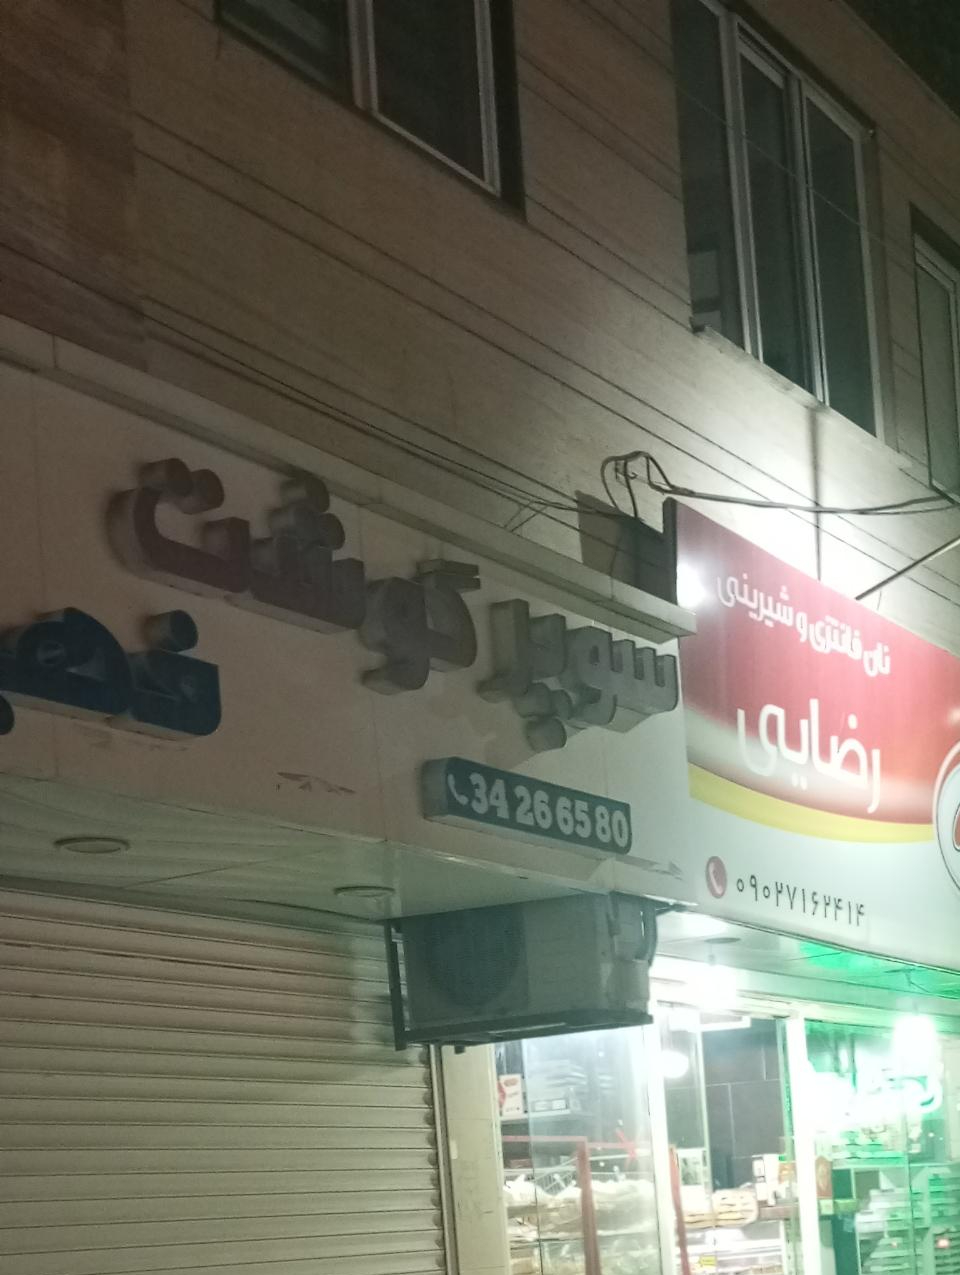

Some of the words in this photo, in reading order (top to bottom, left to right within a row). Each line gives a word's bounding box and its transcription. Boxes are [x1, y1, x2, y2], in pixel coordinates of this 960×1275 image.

[106, 456, 481, 695] گوشت
[716, 572, 795, 628] شیرینی
[795, 610, 809, 643] و
[862, 640, 892, 677] نان
[477, 598, 679, 752] سوپر
[735, 698, 882, 813] رضایی
